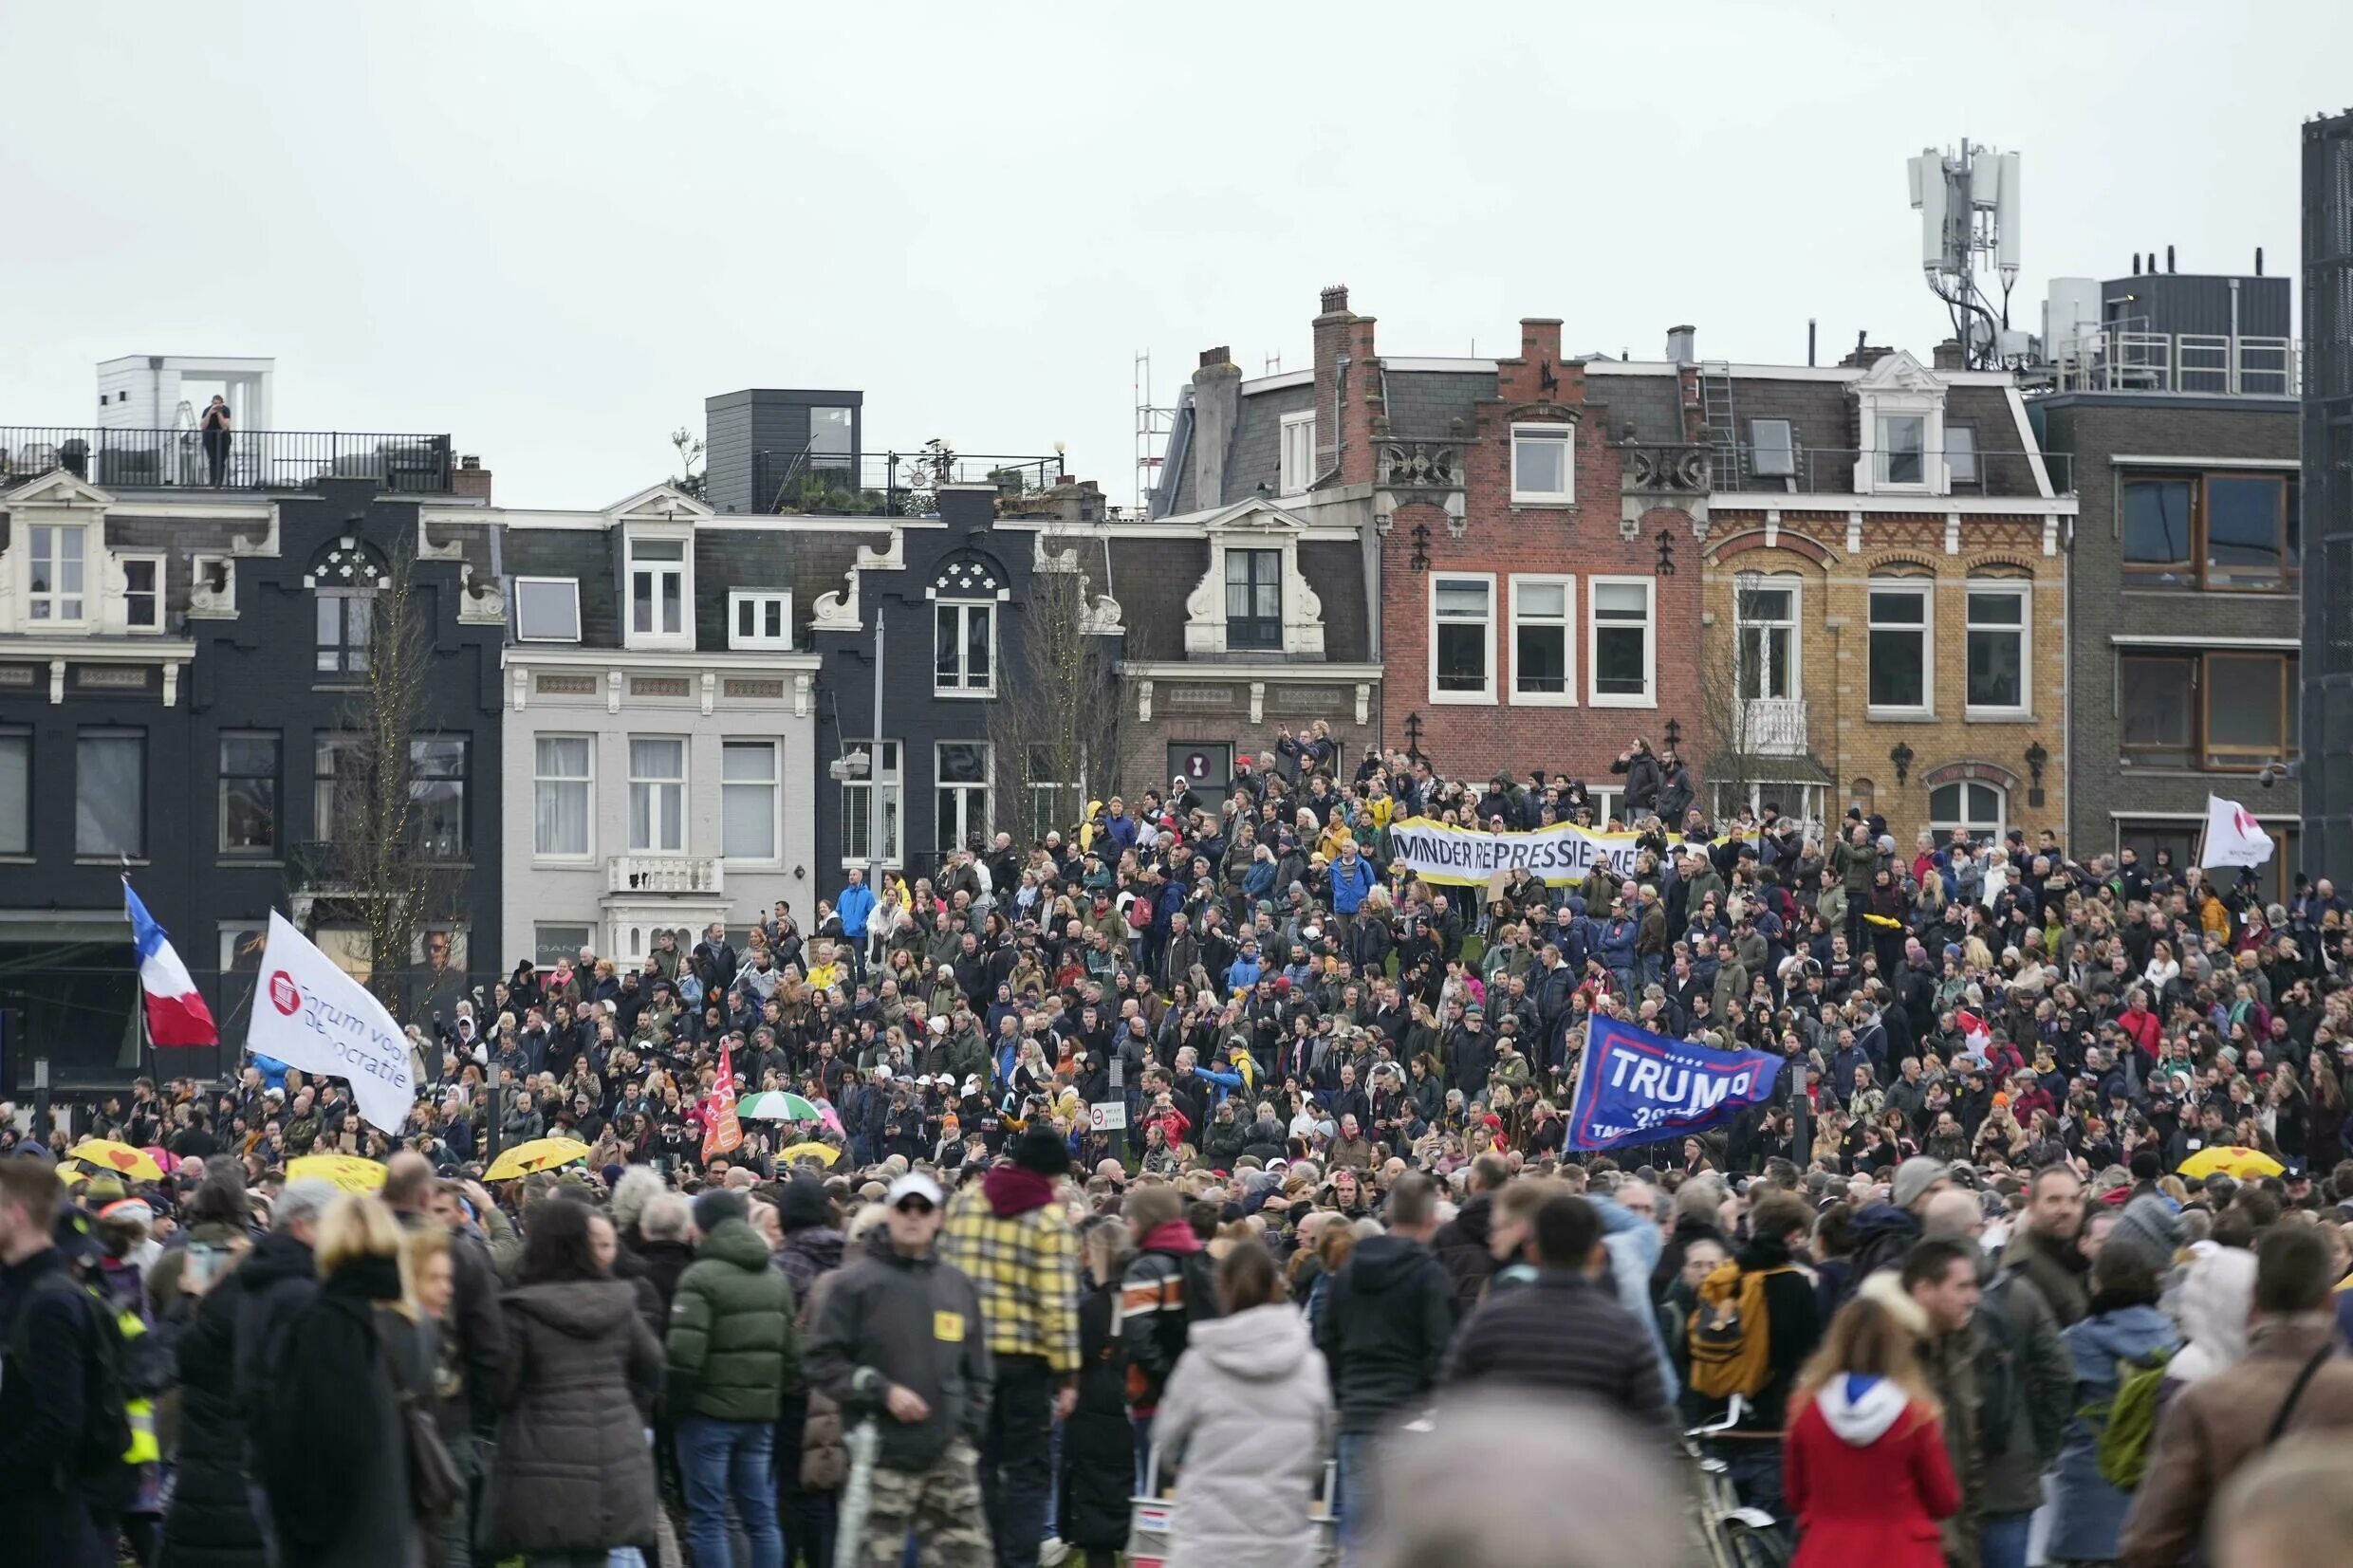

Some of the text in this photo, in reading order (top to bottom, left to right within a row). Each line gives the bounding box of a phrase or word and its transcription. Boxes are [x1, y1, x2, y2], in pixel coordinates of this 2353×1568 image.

[1393, 834, 1472, 869] MINDER
[1475, 839, 1592, 869] REPRESSIE
[305, 1008, 406, 1088] Deocratie
[1611, 1047, 1751, 1109] TRUMP
